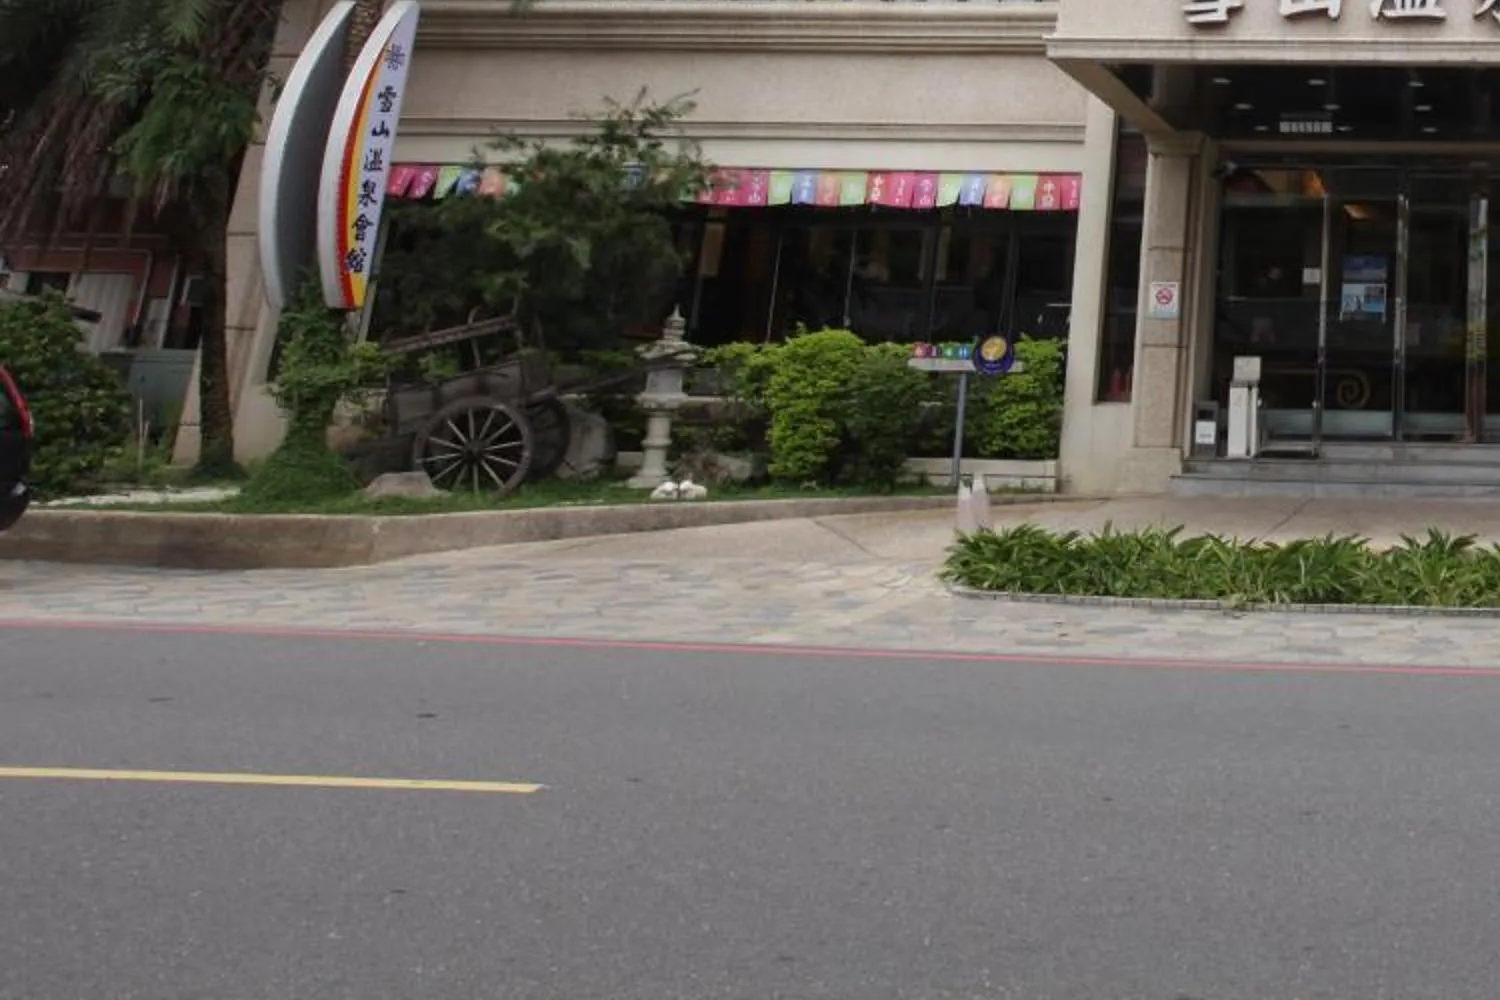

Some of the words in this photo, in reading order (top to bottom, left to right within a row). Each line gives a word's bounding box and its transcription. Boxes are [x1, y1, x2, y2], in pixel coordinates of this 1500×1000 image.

[347, 85, 397, 274] 雪山溫泉會館
